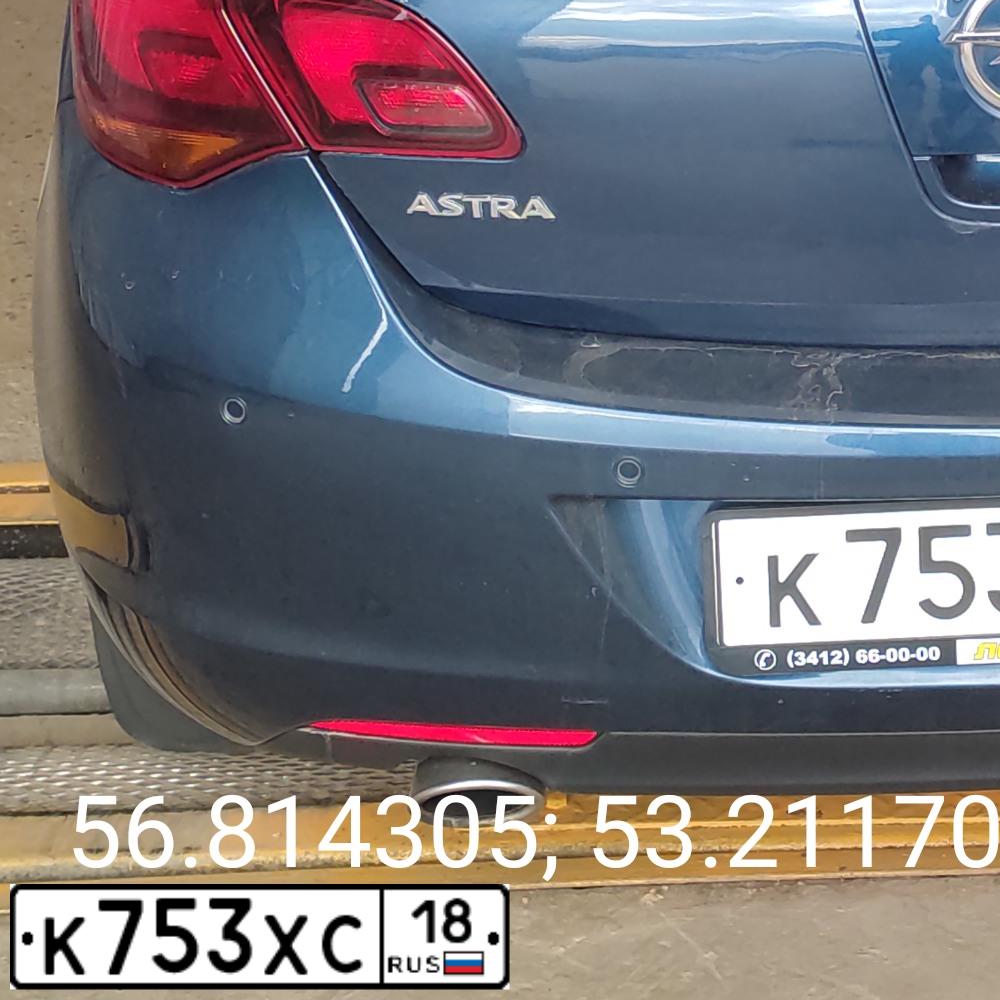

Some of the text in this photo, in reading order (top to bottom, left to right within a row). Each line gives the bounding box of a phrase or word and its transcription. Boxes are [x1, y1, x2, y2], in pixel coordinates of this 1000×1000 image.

[406, 191, 557, 221] ASTRA
[786, 647, 850, 668] (3412)
[855, 645, 941, 664] 66-00-00
